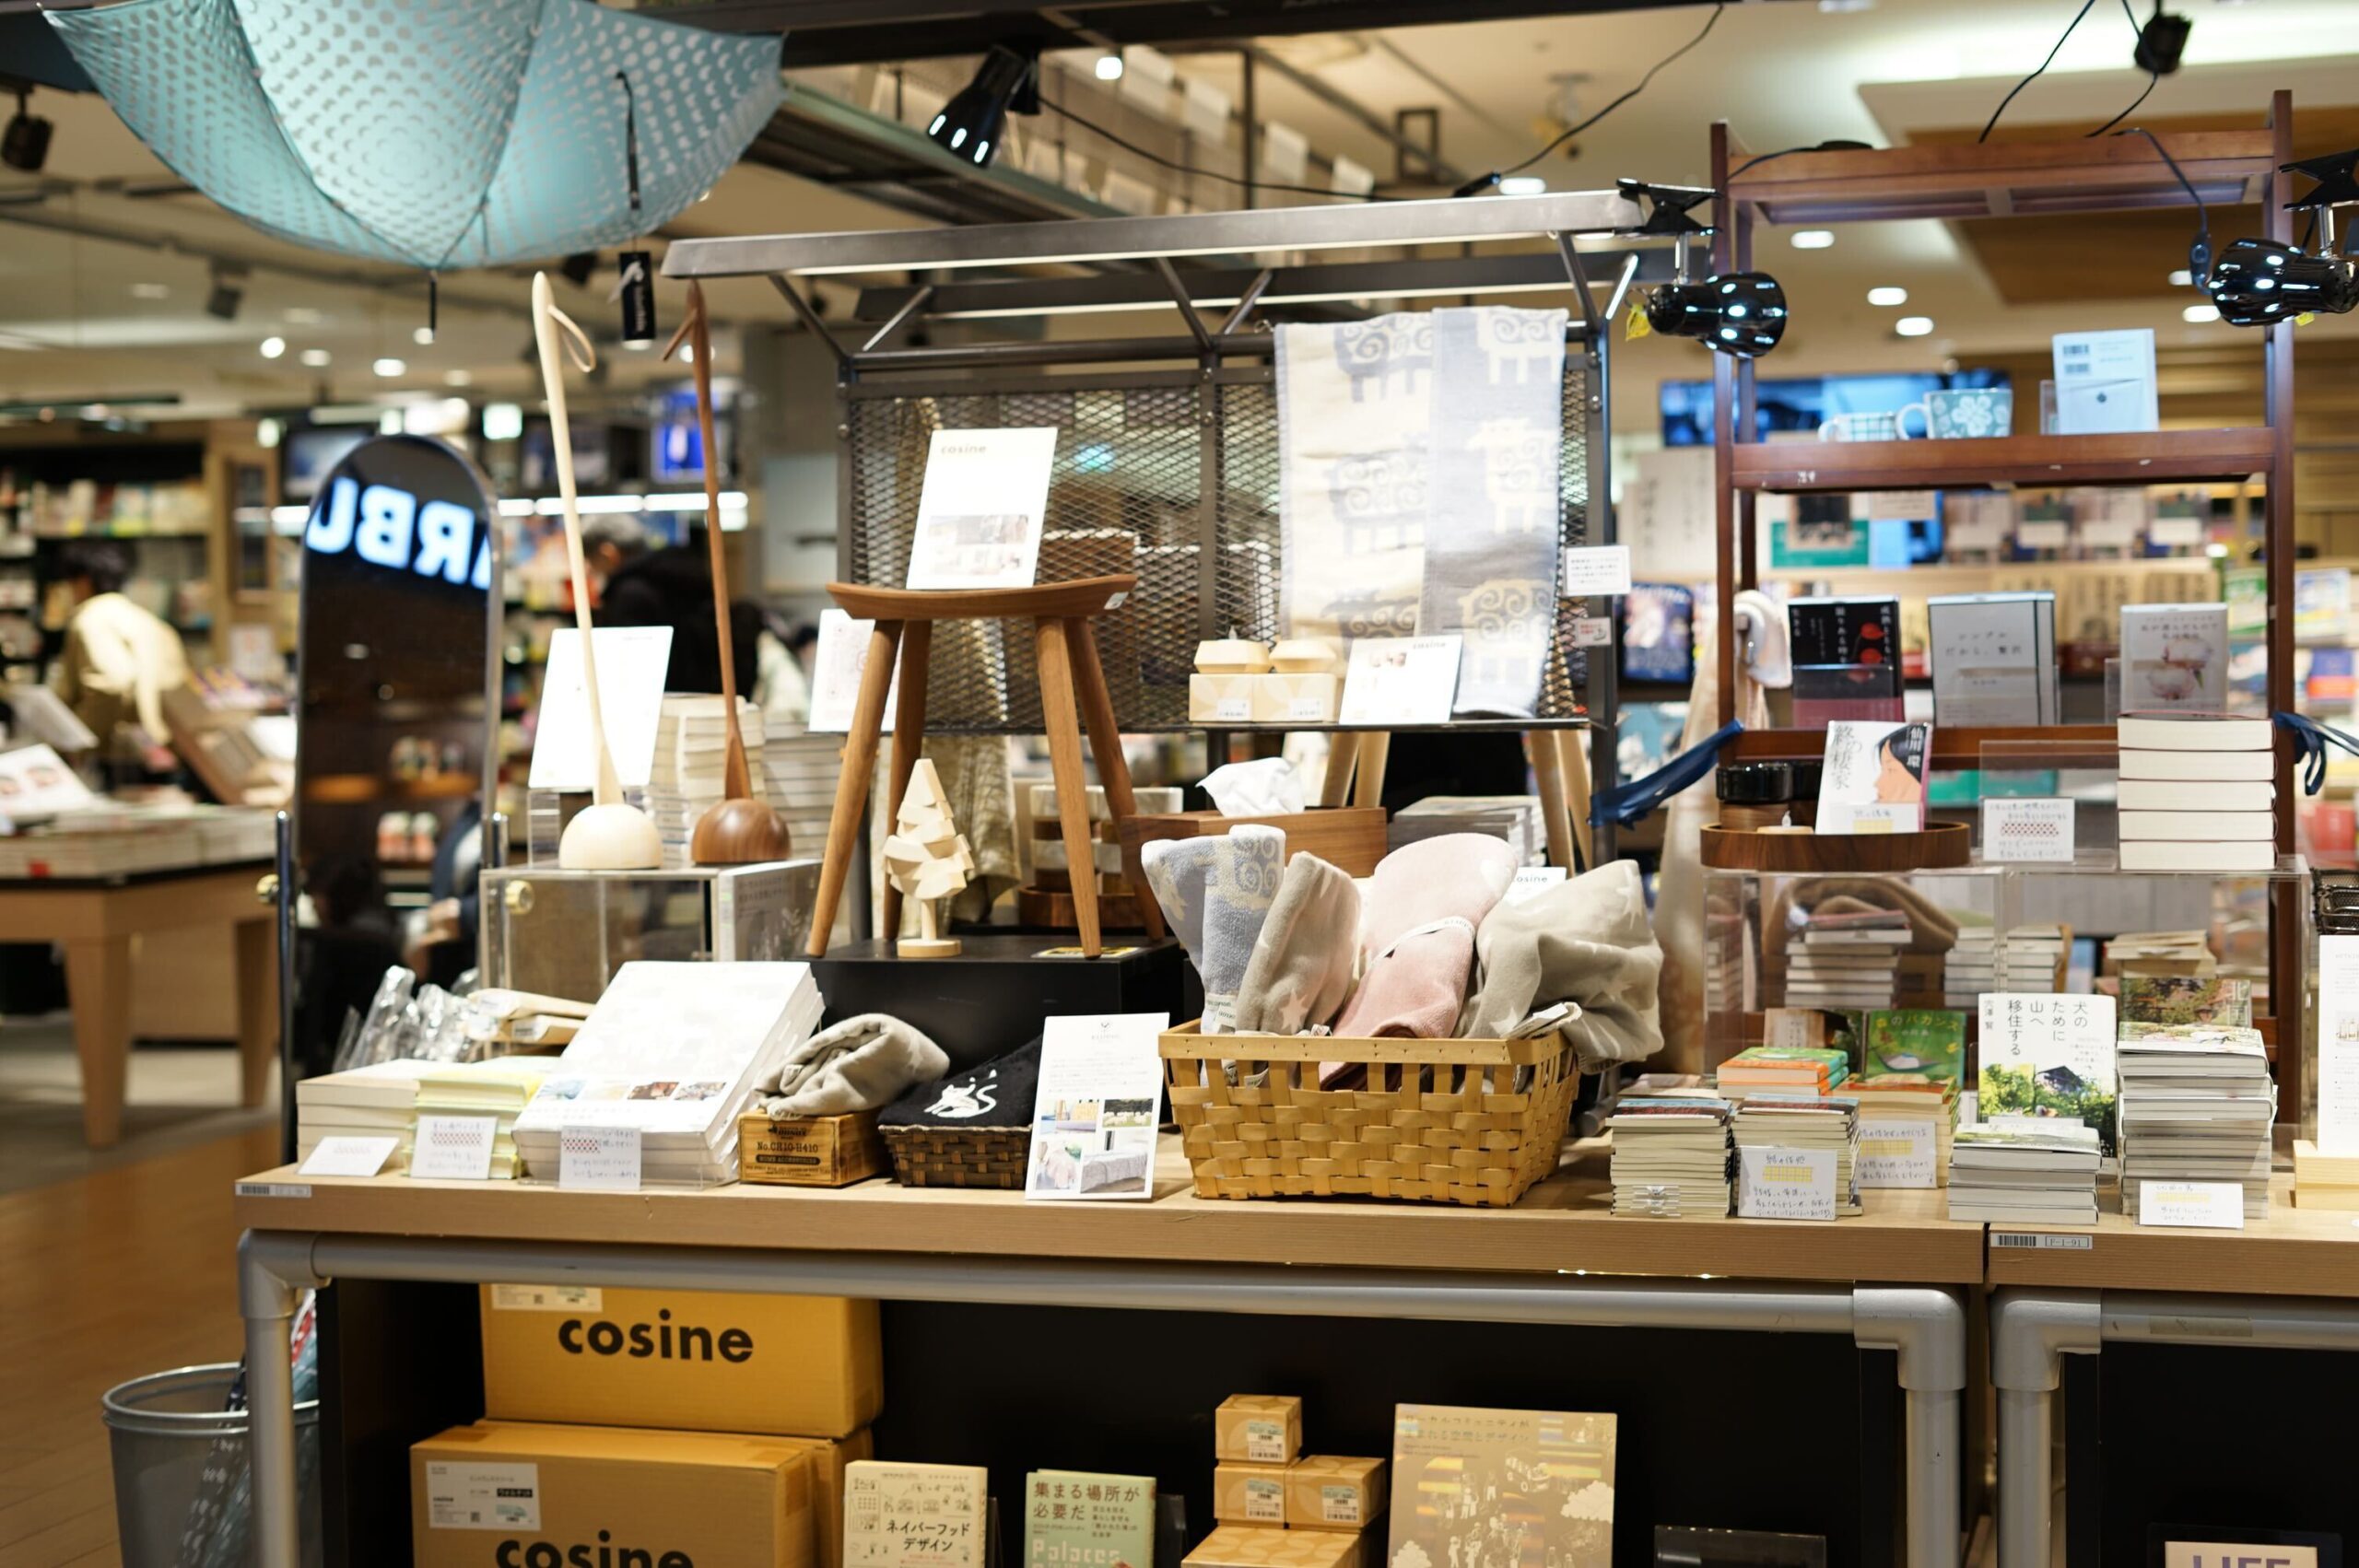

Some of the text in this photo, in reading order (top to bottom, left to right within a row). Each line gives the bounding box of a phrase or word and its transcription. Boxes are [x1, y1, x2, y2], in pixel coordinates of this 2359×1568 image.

[941, 443, 986, 454] cosine
[2030, 1001, 2044, 1025] 山へ
[2052, 1000, 2065, 1042] ために
[2074, 1001, 2088, 1028] 犬の
[2008, 1000, 2024, 1056] 移住する
[557, 1308, 754, 1363] cosine
[1034, 1480, 1140, 1503] 集まる場所が
[1033, 1503, 1086, 1521] 必要だ
[886, 1520, 970, 1537] ネイバーフッド
[496, 1529, 694, 1568] cosine
[904, 1538, 953, 1552] デザイン
[1032, 1539, 1121, 1565] Palaces
